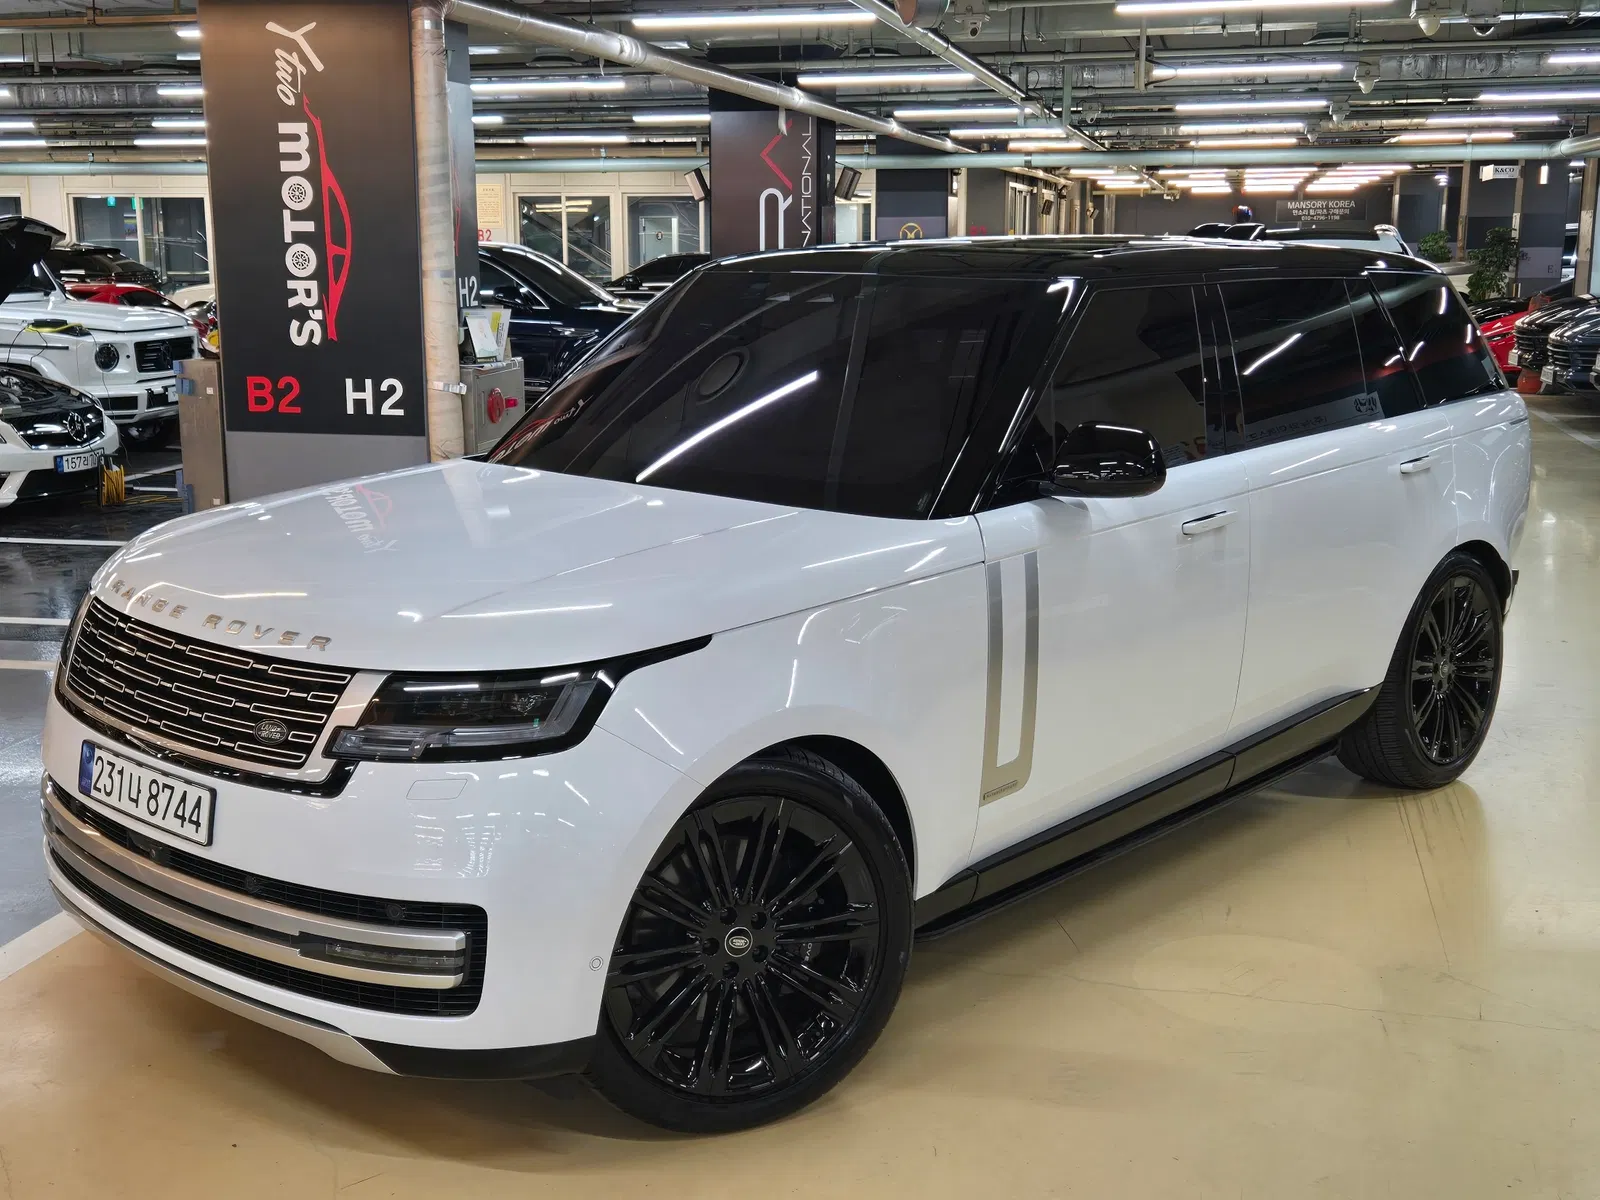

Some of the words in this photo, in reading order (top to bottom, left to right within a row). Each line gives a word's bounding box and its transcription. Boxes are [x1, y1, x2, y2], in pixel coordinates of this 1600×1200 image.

[1287, 200, 1327, 209] MANSORY
[1328, 200, 1356, 208] KOREA
[458, 275, 479, 308] H2
[246, 376, 302, 414] B2
[345, 377, 405, 416] H2
[110, 579, 189, 619] RANGE
[201, 613, 333, 652] ROVER
